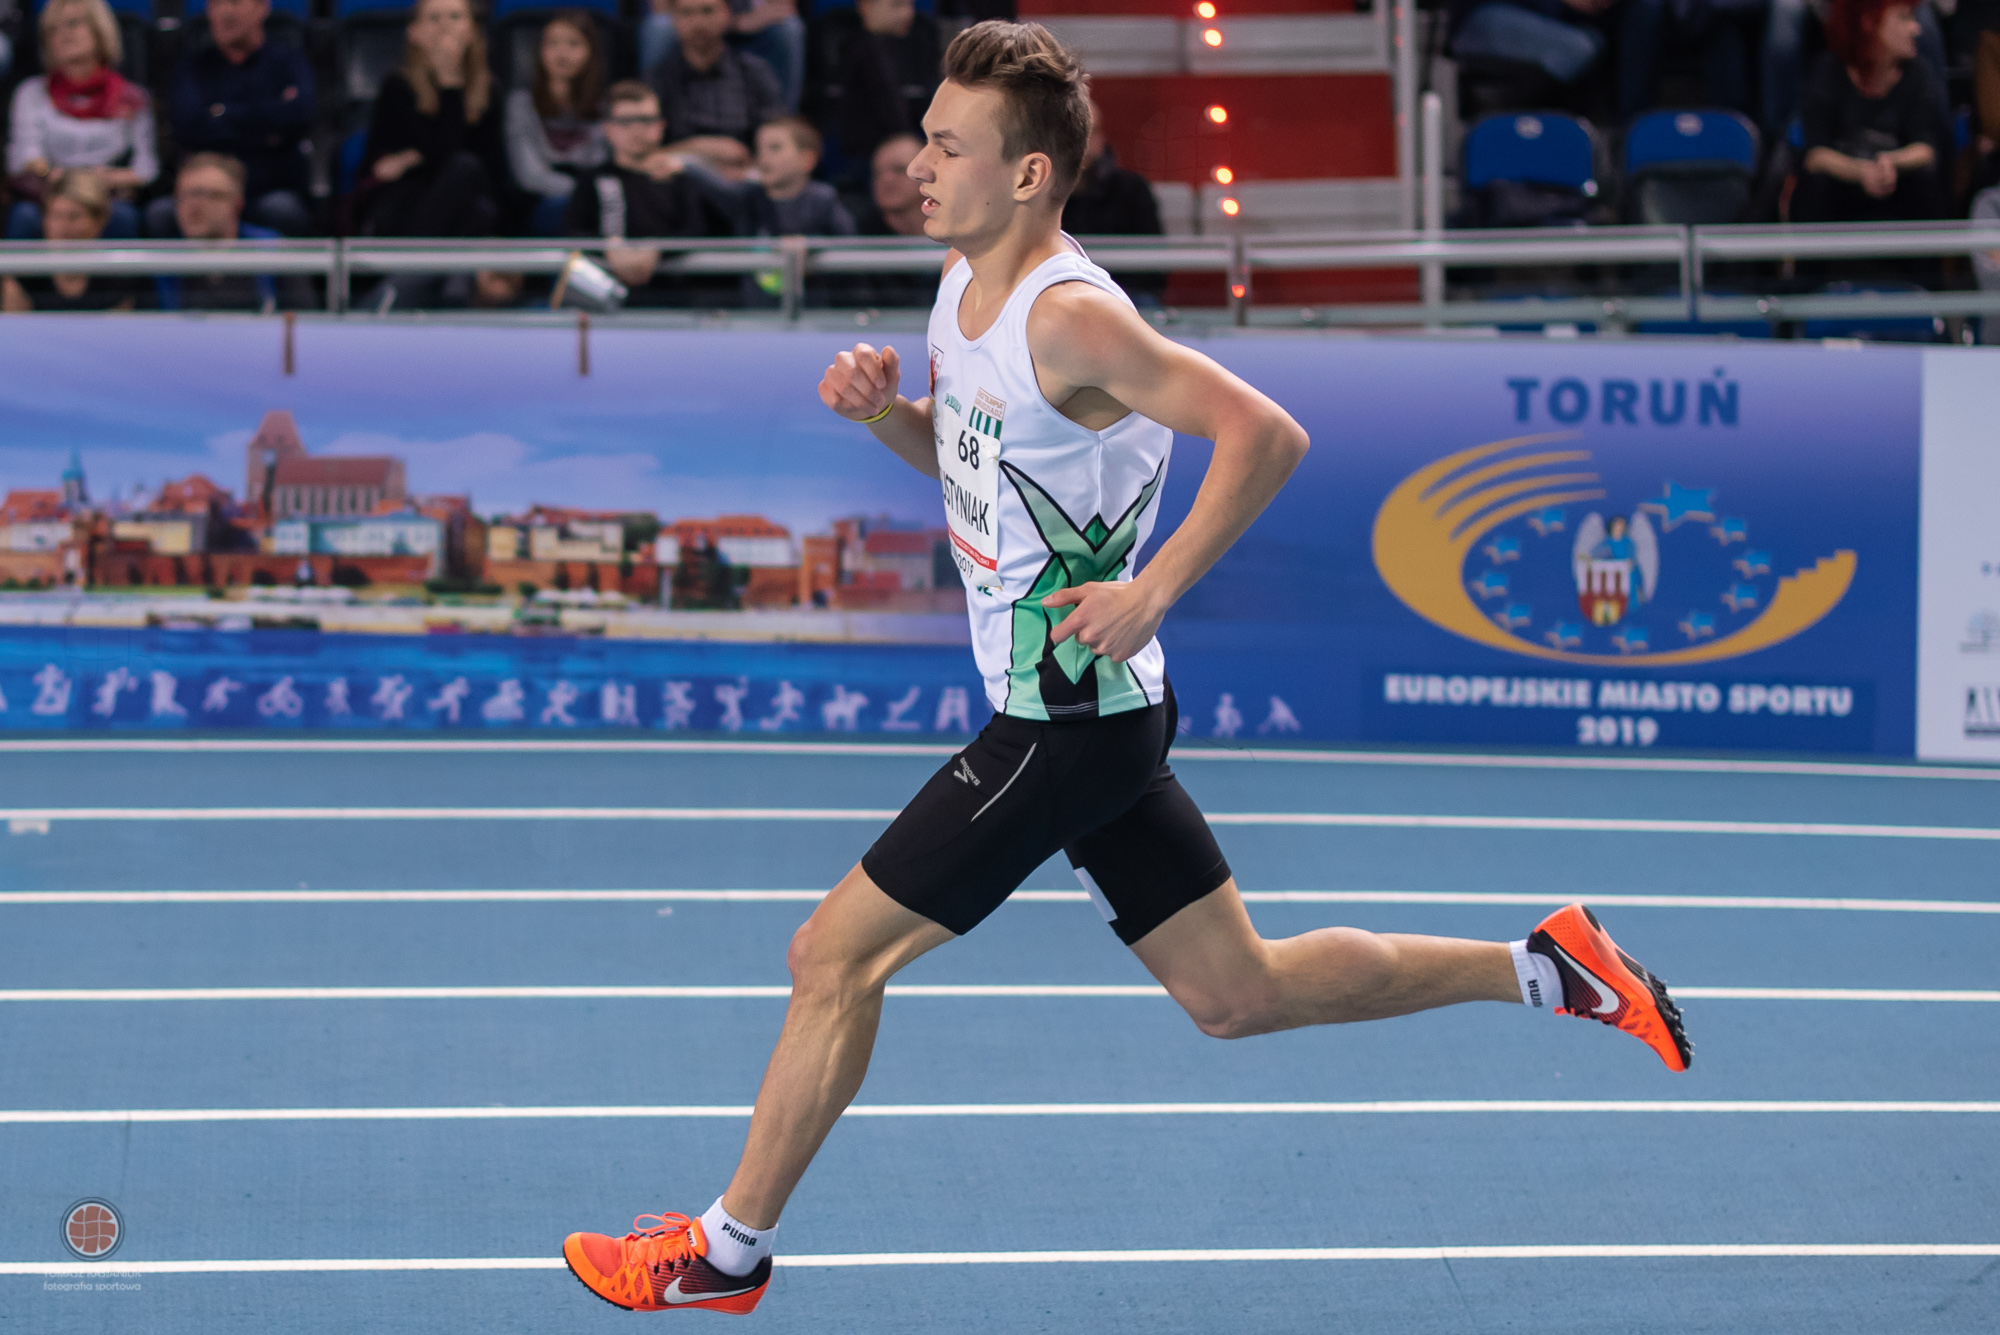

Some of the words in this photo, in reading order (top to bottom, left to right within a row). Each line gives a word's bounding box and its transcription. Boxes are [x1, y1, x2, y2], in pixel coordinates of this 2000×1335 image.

[1506, 368, 1739, 427] TORUŃ
[957, 430, 980, 471] 68
[1384, 674, 1592, 708] EUROPEJSKIE
[1597, 681, 1721, 713] MIASTO
[1728, 684, 1853, 716] SPORTU
[1577, 716, 1659, 746] 2019
[960, 757, 981, 786] BROOKS
[722, 1222, 757, 1247] PUMA
